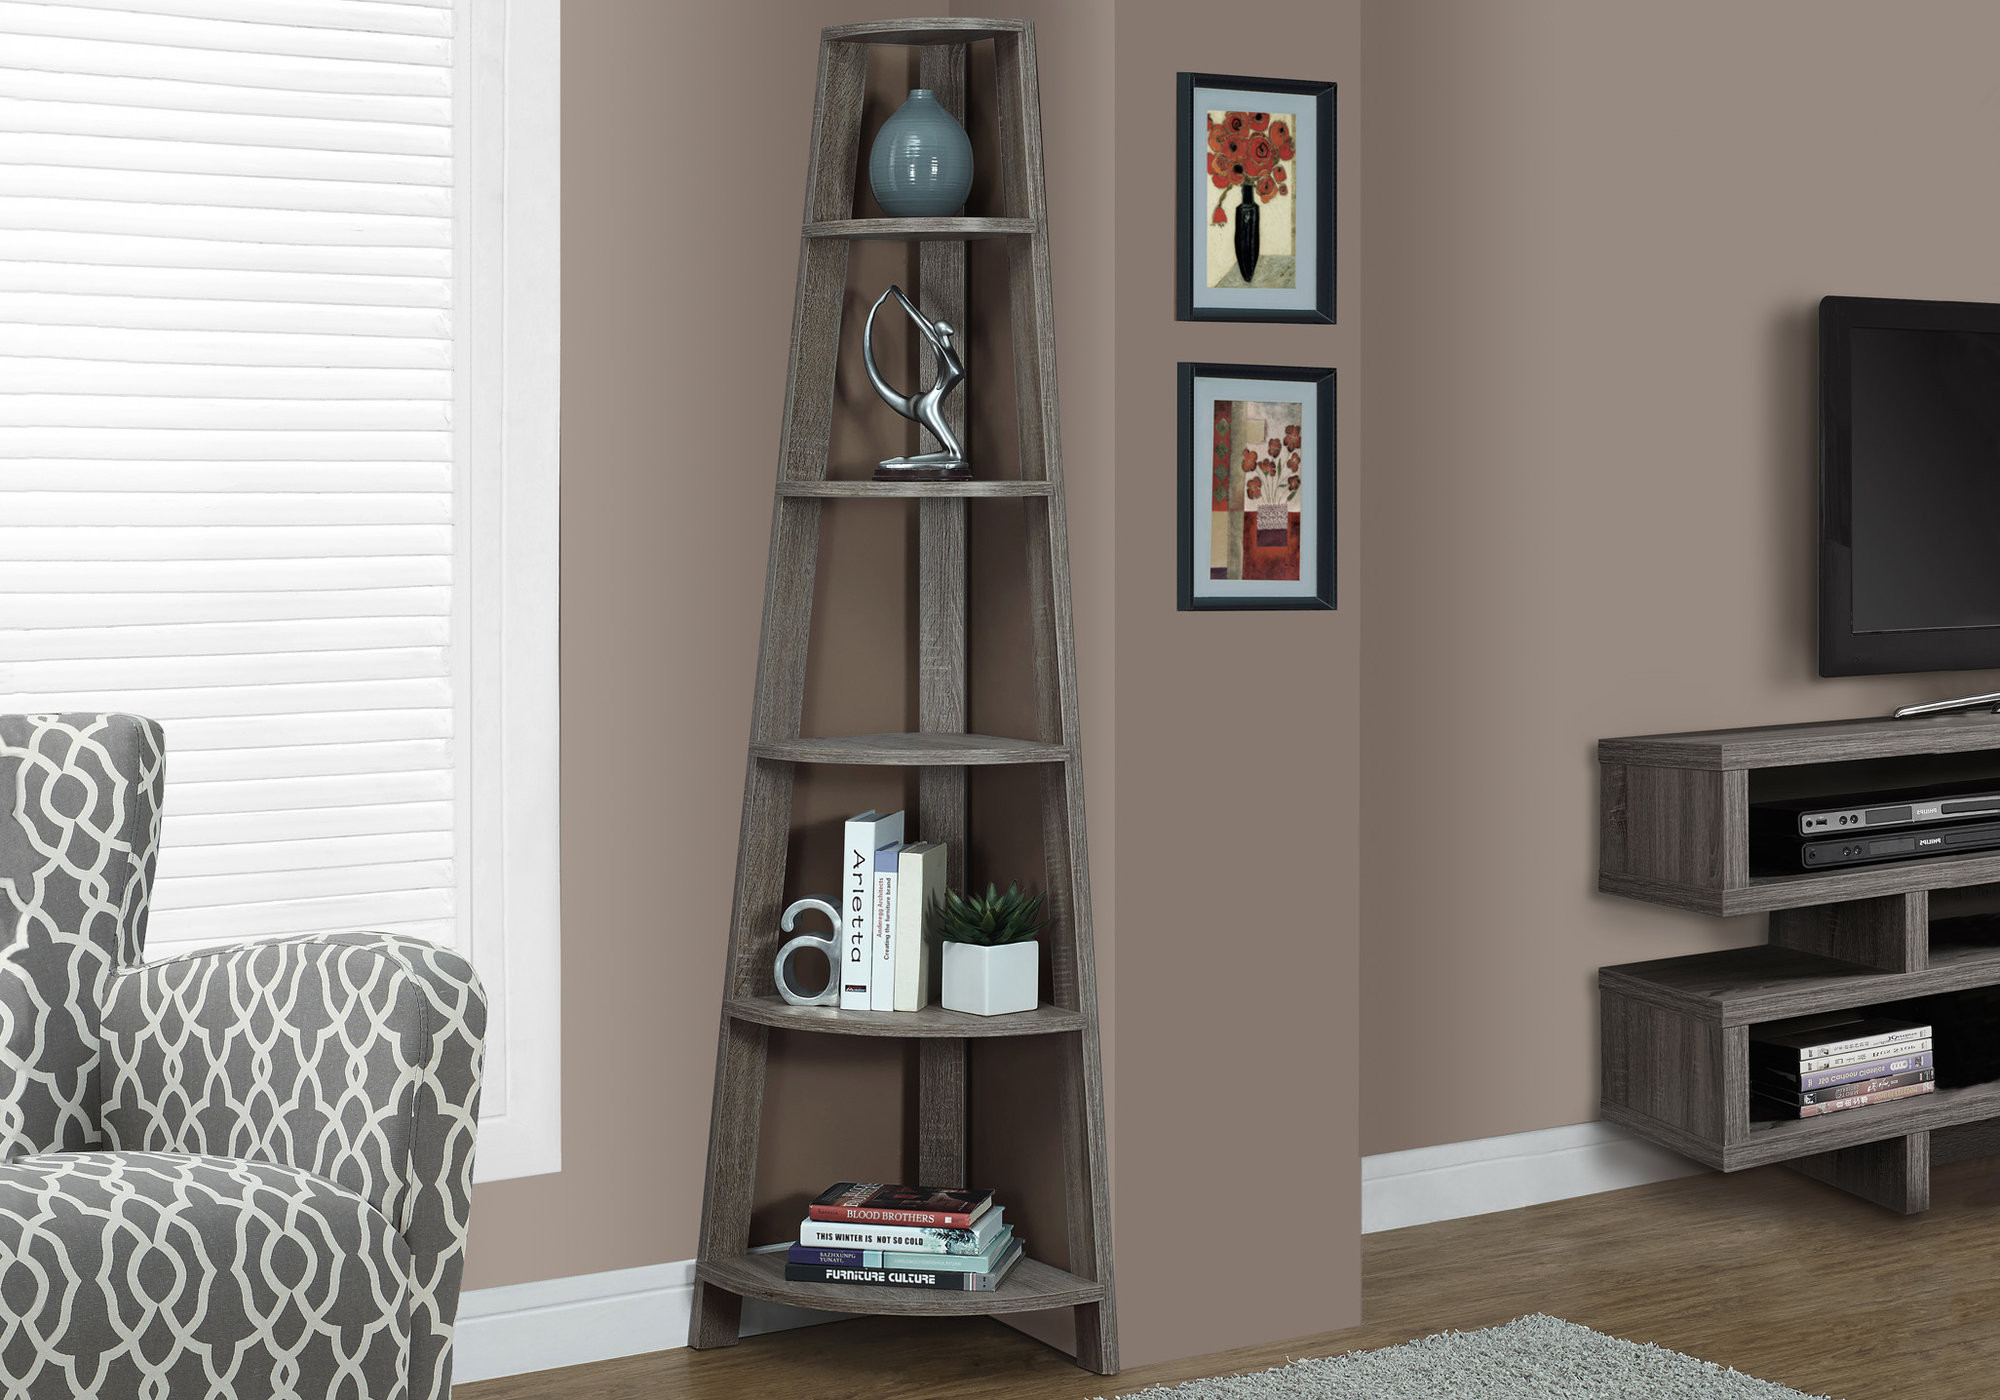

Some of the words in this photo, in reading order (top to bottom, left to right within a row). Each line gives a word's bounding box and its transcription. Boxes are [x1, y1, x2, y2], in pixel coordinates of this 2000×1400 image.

[850, 848, 866, 963] Arletta
[883, 934, 891, 961] Creating
[846, 1209, 881, 1221] BLOOD
[881, 1211, 935, 1224] BROTHERS
[816, 1232, 834, 1241] THIS
[835, 1232, 863, 1243] WINTER
[864, 1233, 873, 1243] IS
[876, 1234, 892, 1244] NOT
[892, 1235, 903, 1245] SO
[904, 1236, 924, 1246] COLD
[825, 1269, 886, 1282] FURNITURE
[888, 1272, 936, 1285] CULTURE
